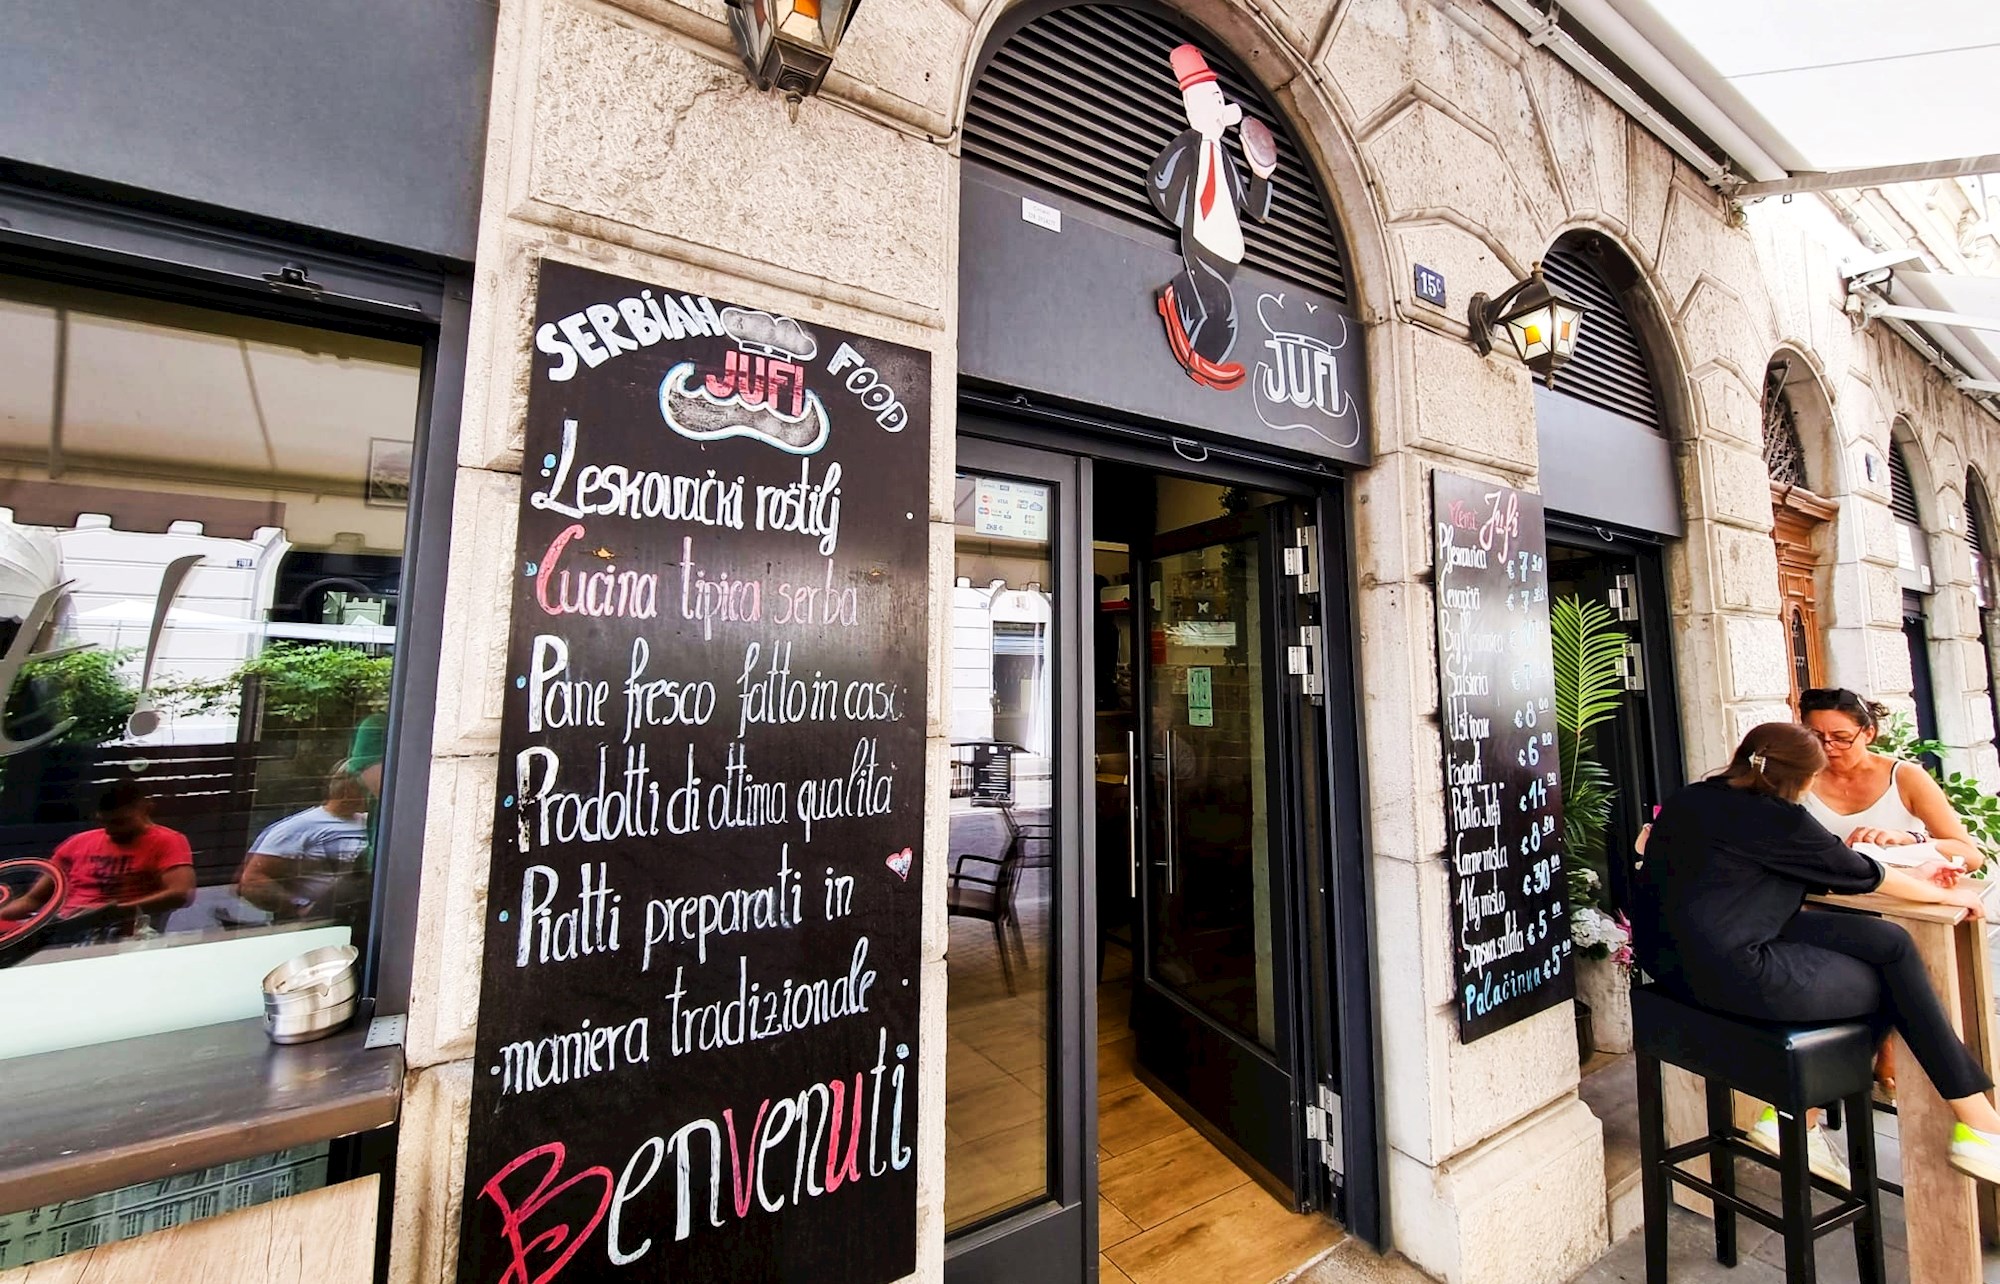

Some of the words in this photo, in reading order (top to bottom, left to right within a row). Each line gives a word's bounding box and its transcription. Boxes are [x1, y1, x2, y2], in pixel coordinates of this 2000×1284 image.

[705, 350, 804, 418] JUFI
[827, 342, 909, 434] FOOD
[1264, 339, 1340, 412] JUFI
[535, 523, 659, 620] Cucina
[679, 535, 762, 641] tipica
[773, 558, 860, 627] serba
[528, 634, 610, 733] Pane
[623, 637, 716, 744] fresco
[737, 640, 807, 739] fatto
[812, 670, 840, 722] in
[516, 741, 660, 853] Prodotti
[666, 742, 701, 835] di
[708, 741, 789, 832] ottima
[516, 861, 622, 968] Piatti
[640, 842, 802, 972] preparati
[824, 866, 854, 921] in
[499, 1017, 650, 1096] maniera
[665, 936, 877, 1057] tradizionale
[476, 1027, 912, 1284] Benvenuti
